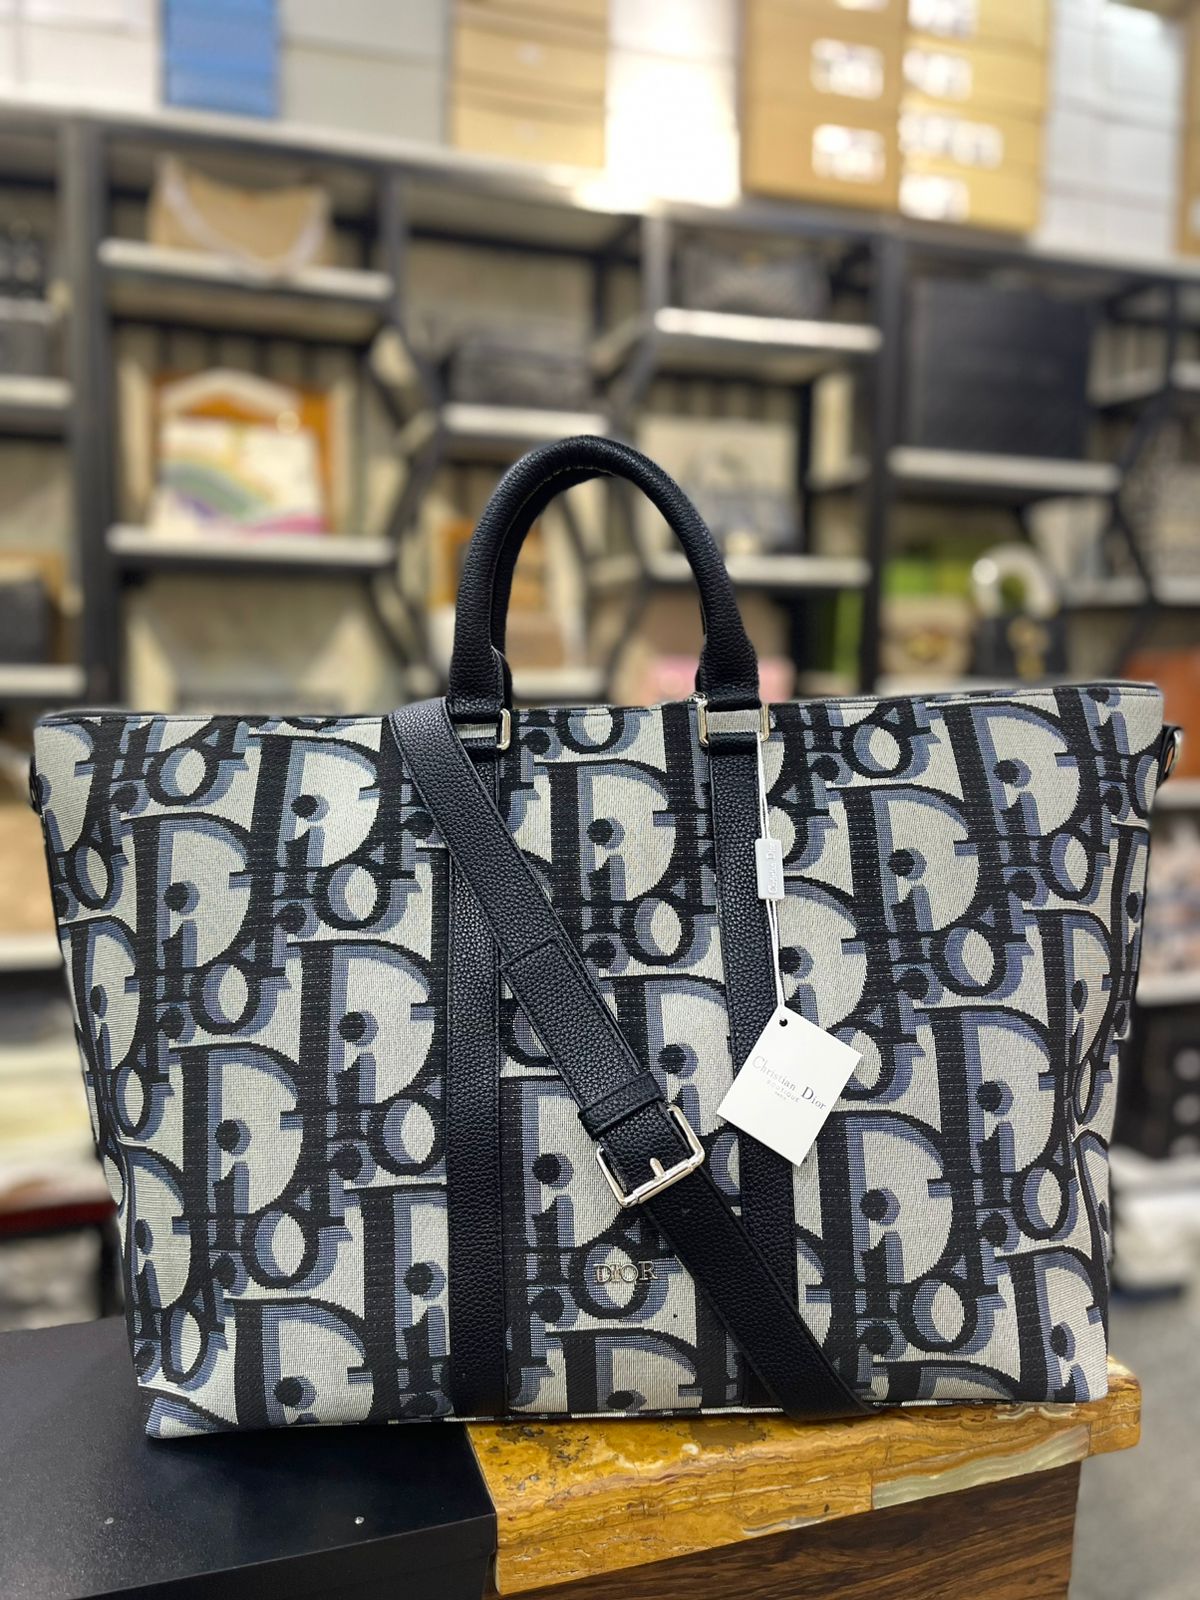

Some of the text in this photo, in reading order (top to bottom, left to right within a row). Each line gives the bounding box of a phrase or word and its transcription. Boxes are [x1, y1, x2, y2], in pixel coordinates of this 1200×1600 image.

[752, 1055, 827, 1110] Christian Dior
[593, 1261, 658, 1282] DIOR
